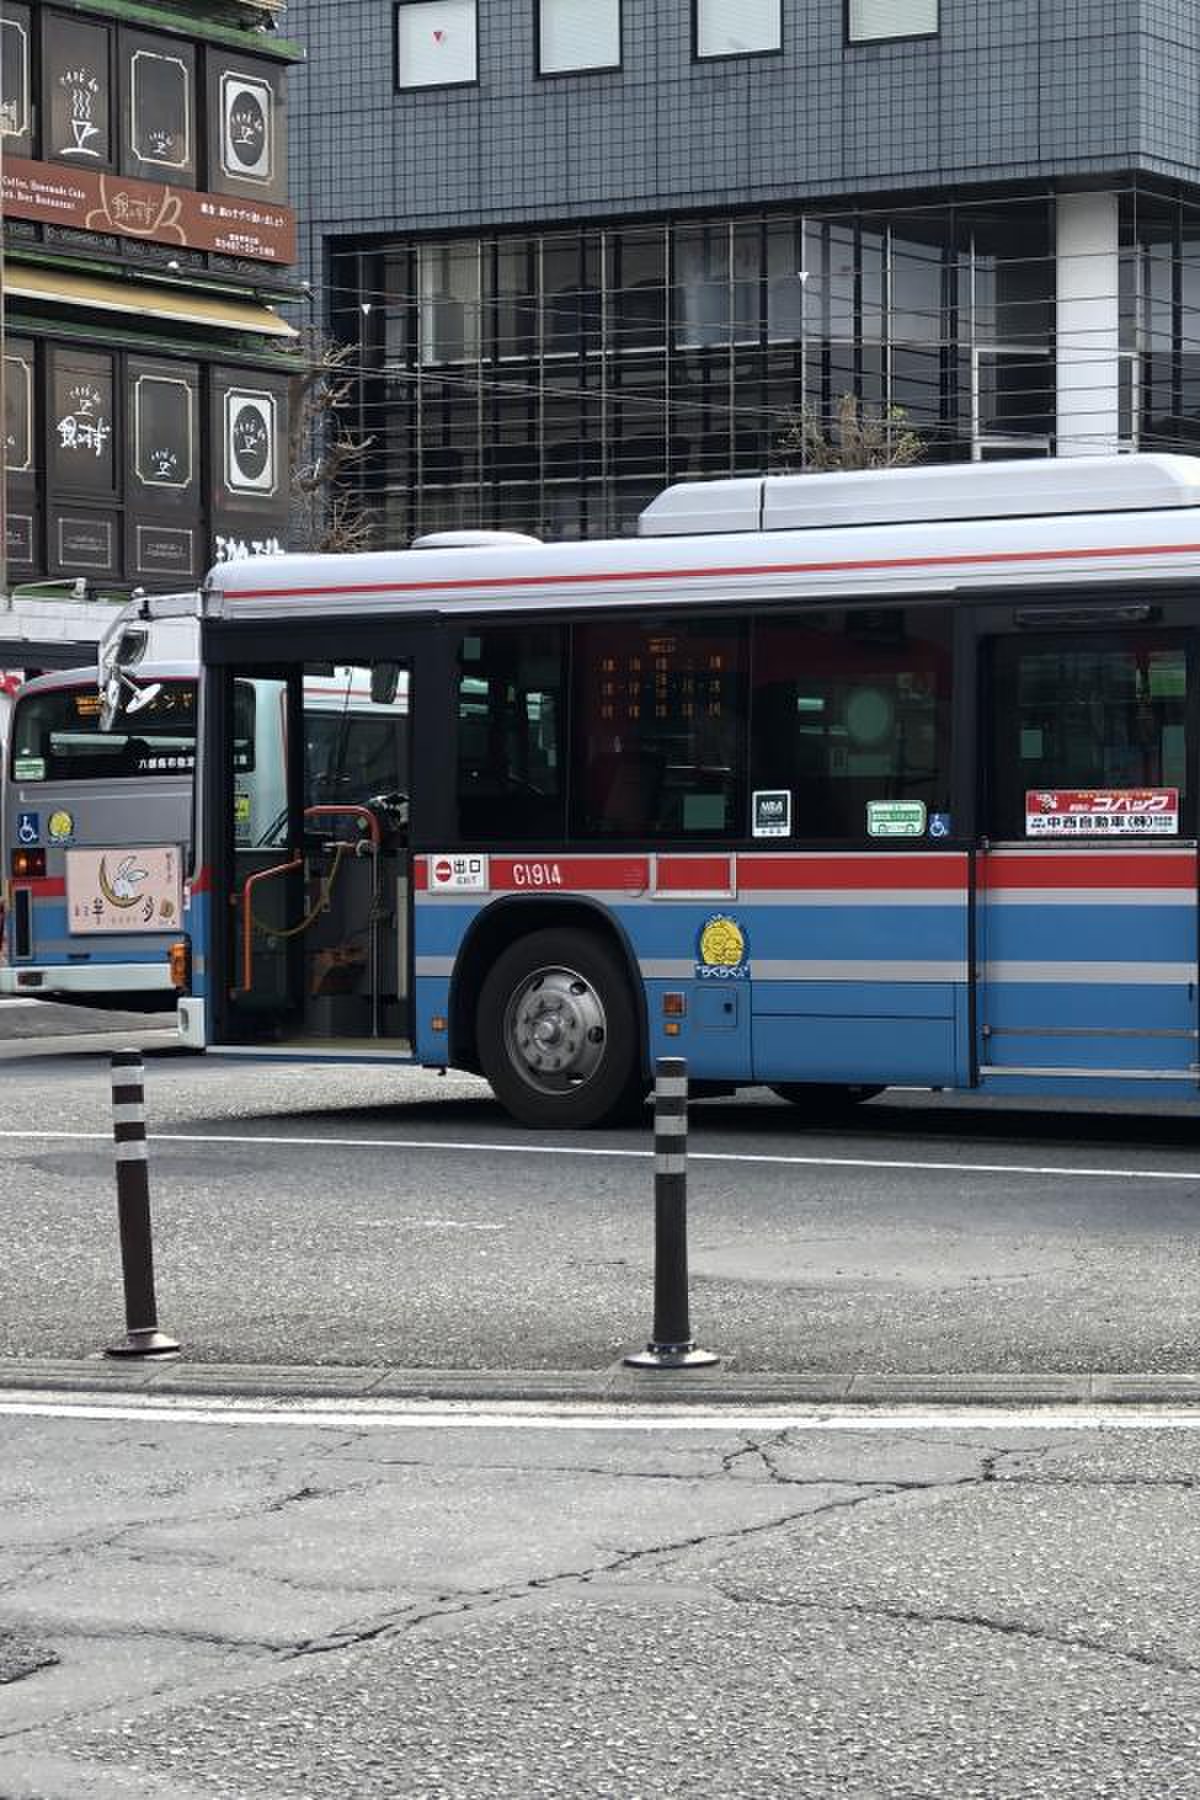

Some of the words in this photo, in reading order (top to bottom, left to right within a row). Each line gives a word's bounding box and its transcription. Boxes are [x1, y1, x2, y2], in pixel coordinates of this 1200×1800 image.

[453, 858, 481, 874] 出口
[456, 875, 477, 886] EXIT
[512, 863, 562, 886] C1914
